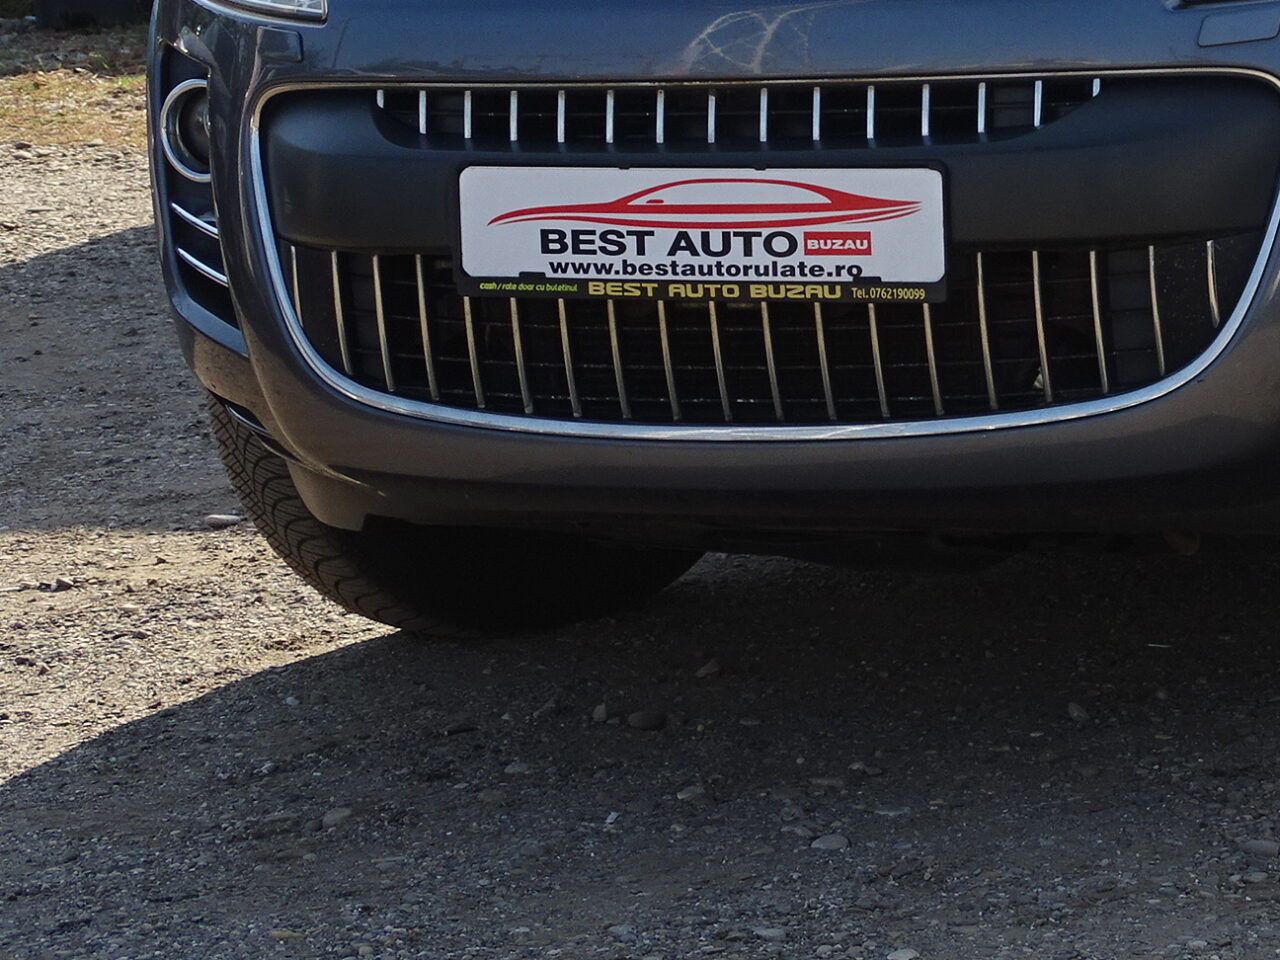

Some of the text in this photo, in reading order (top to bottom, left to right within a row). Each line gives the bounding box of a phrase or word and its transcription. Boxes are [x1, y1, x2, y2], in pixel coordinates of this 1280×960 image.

[540, 228, 869, 258] BEST AUTO BUZAU
[548, 259, 864, 279] www.bestautorulate.ro
[587, 281, 842, 300] BEST AUTO BUZAU
